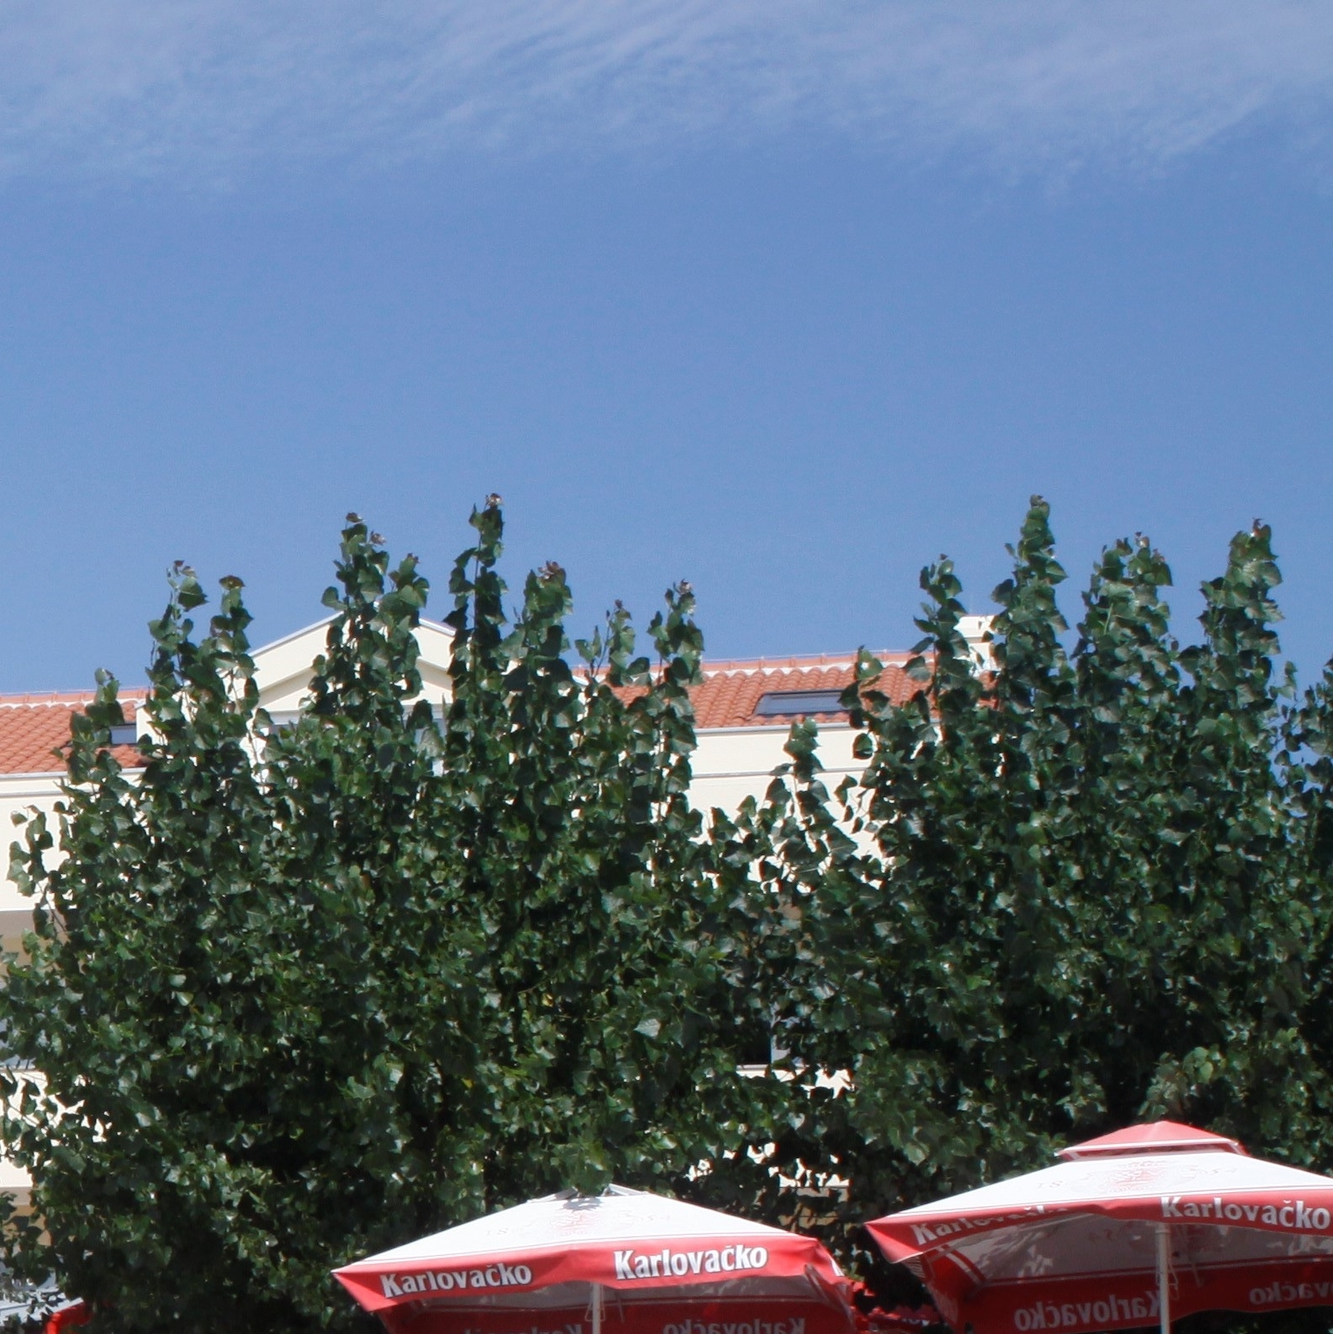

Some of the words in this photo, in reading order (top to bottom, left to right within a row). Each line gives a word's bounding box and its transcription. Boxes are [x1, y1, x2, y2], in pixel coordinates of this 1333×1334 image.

[1160, 1196, 1331, 1230] Karlovačko
[380, 1262, 532, 1299] Karlovačko
[614, 1244, 768, 1281] Karlovačko
